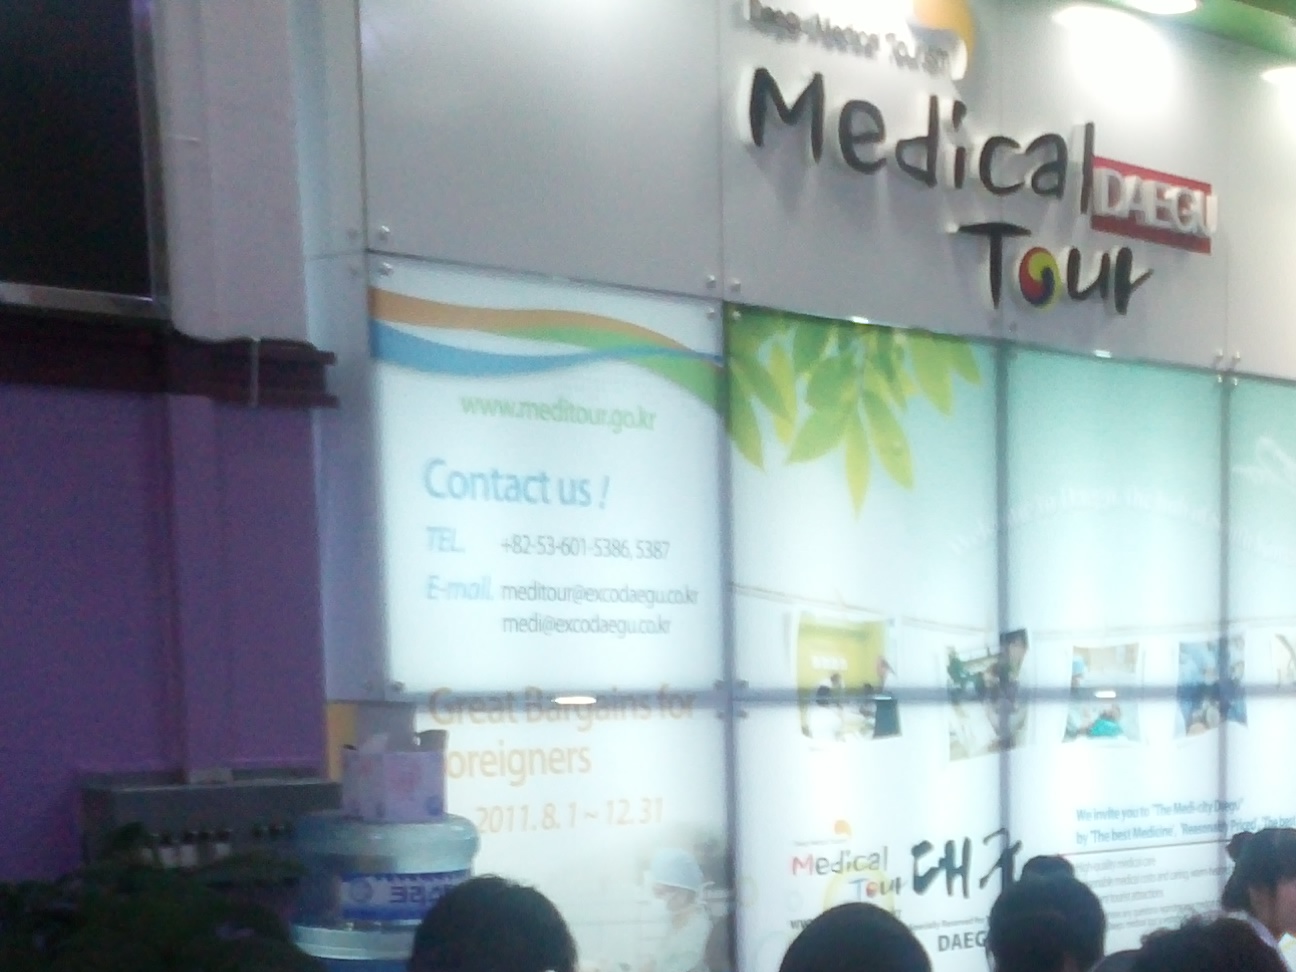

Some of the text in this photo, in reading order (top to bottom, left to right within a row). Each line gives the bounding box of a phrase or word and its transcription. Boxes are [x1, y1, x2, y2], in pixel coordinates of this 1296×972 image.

[748, 66, 1218, 236] Medical DAEGU
[955, 221, 1153, 314] Tour
[460, 395, 656, 434] www.meditour.go.kr
[423, 457, 550, 504] Contact
[558, 475, 592, 507] us
[636, 540, 671, 560] 5387
[428, 683, 697, 733] Great Bargains for
[445, 739, 591, 787] oreigners
[791, 845, 888, 876] Medical
[849, 877, 908, 902] Tour
[938, 930, 987, 952] DAEG
